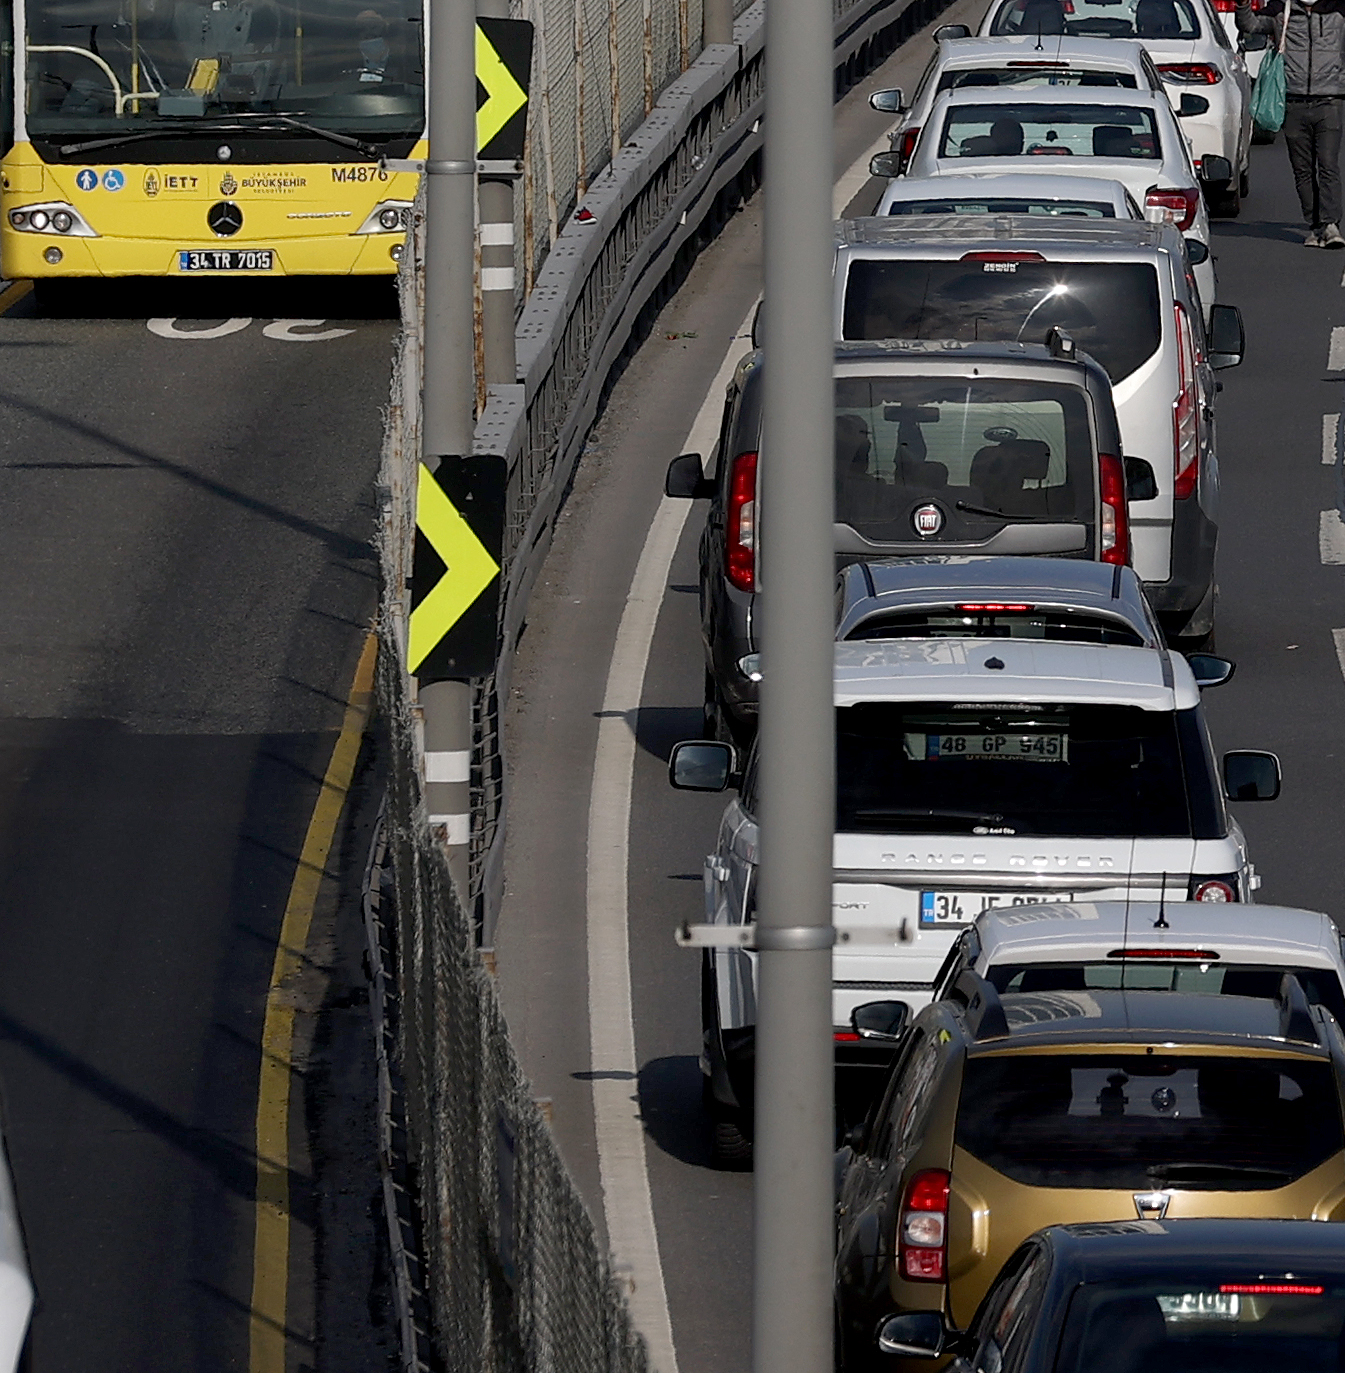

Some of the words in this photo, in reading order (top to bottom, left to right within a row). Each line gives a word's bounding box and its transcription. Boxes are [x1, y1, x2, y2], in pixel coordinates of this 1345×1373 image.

[164, 173, 199, 188] İETT
[331, 167, 389, 183] M4876
[189, 253, 211, 270] 34
[213, 252, 231, 270] TR
[237, 251, 271, 269] 7015
[942, 736, 967, 754] 48
[981, 736, 1007, 753] GP
[936, 895, 963, 921] 34
